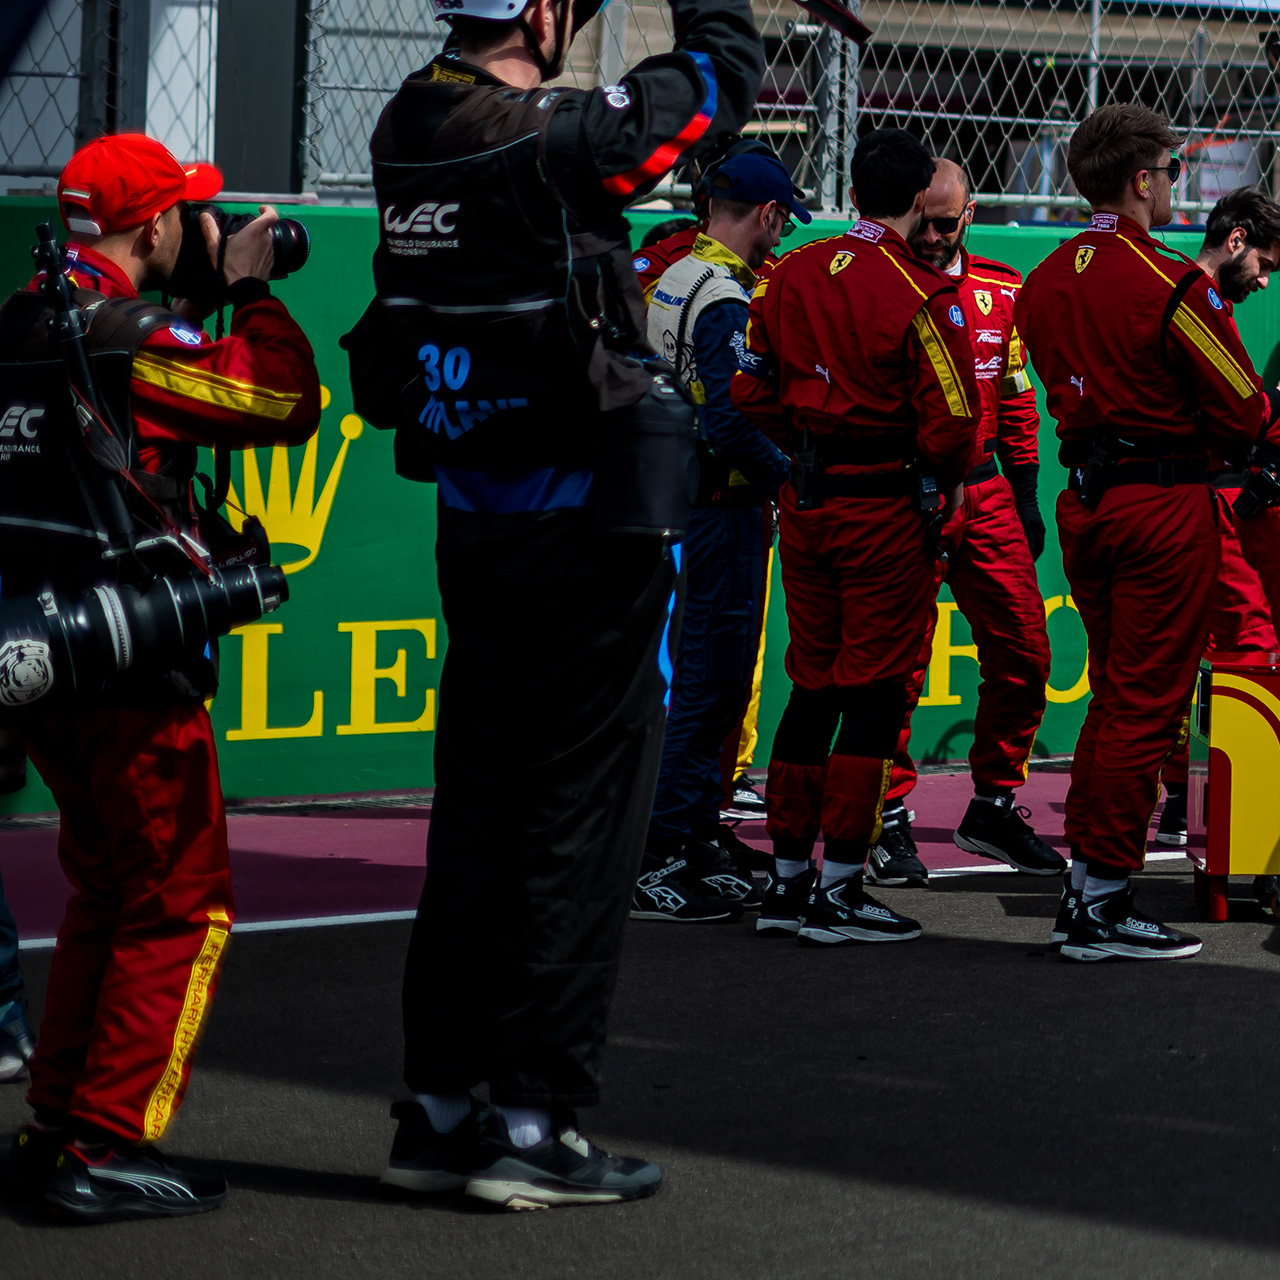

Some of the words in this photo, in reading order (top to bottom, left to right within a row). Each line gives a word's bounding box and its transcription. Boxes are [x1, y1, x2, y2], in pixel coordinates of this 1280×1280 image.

[384, 203, 460, 234] WEC
[417, 344, 471, 392] 30
[0, 406, 45, 438] EC
[1125, 917, 1160, 932] sparco
[186, 942, 221, 1027] FERRARI
[150, 1028, 195, 1139] HYPERCAR
